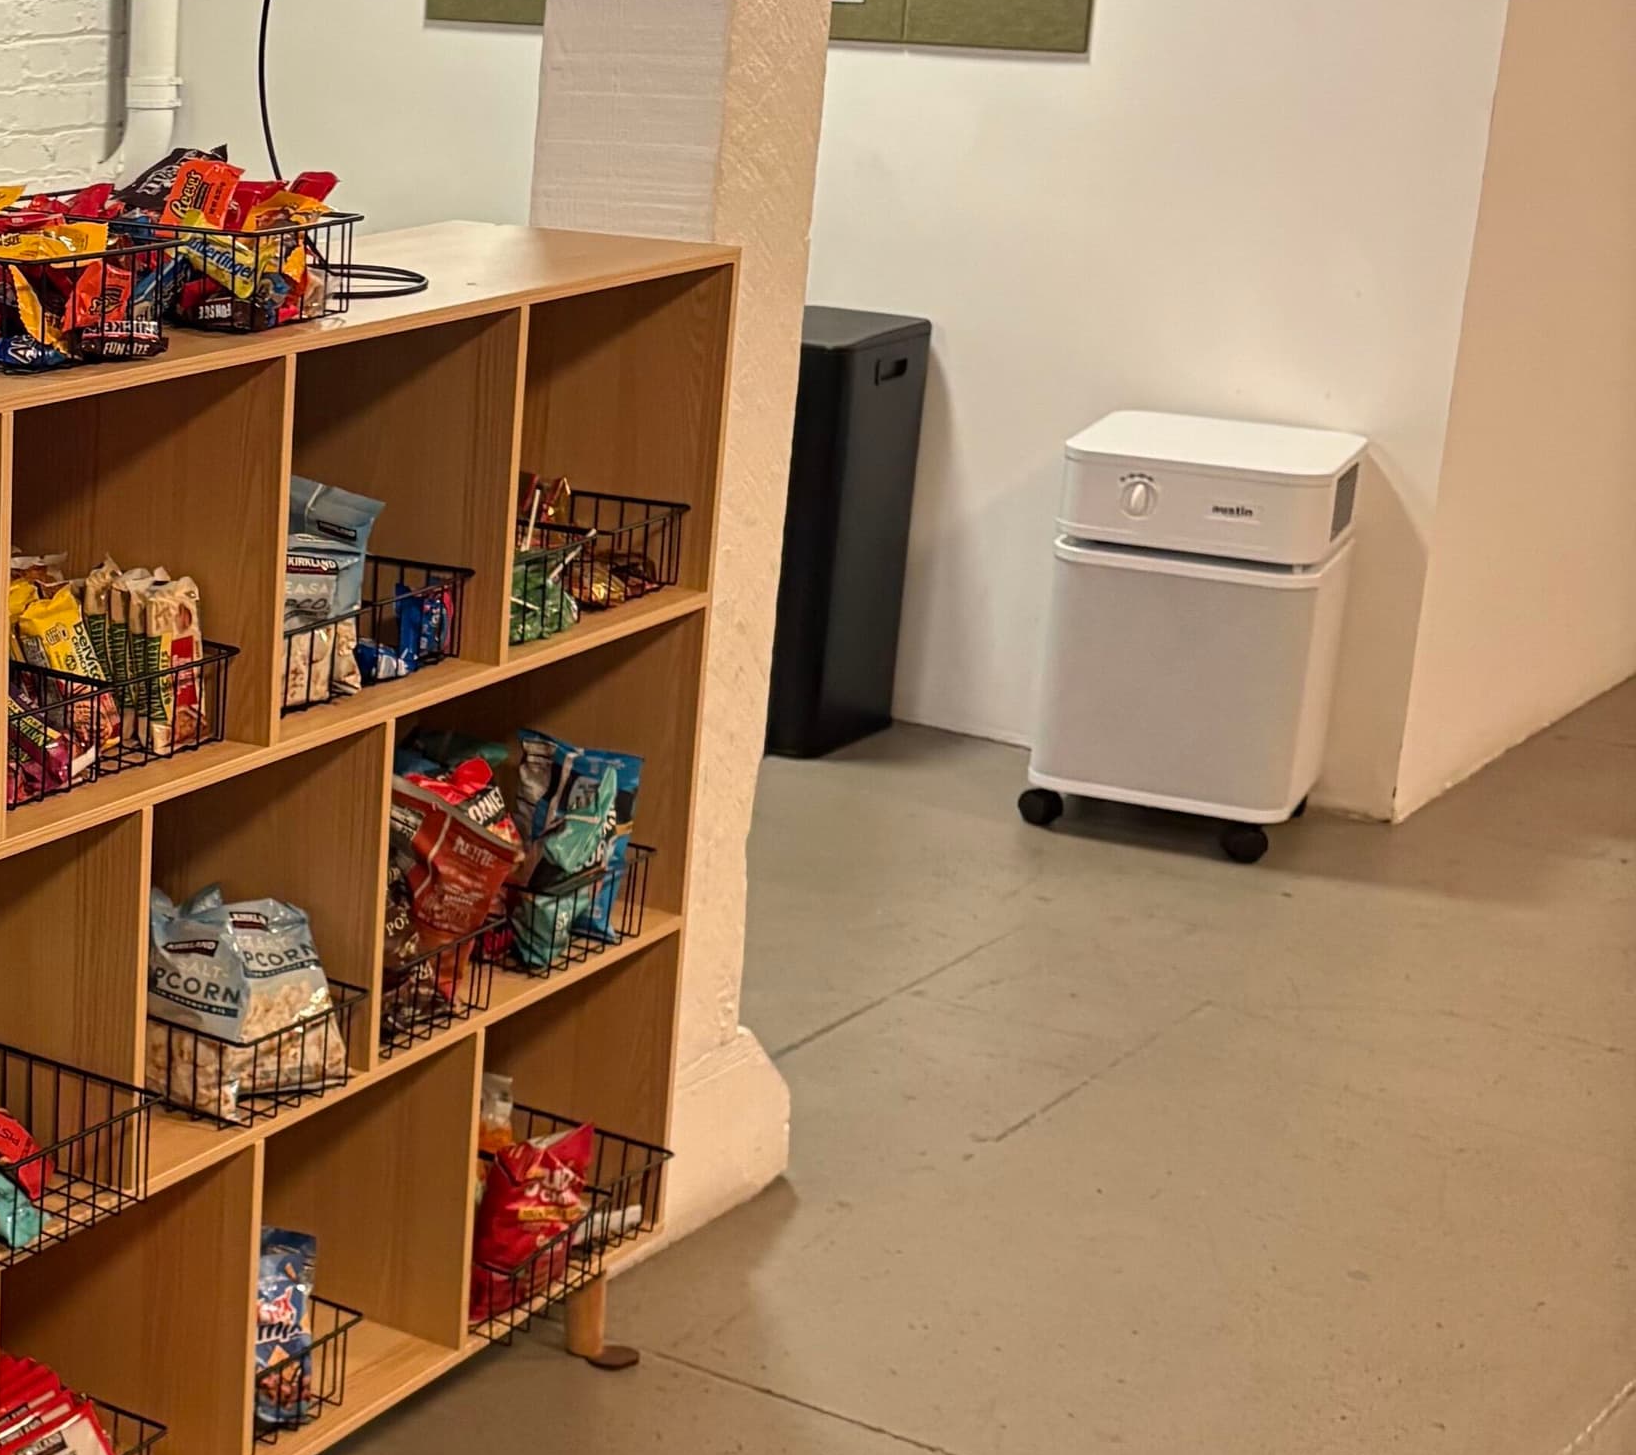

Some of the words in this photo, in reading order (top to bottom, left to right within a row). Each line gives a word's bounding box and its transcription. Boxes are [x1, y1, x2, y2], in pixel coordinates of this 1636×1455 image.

[170, 169, 203, 219] Reese's
[102, 339, 126, 356] FUN
[242, 943, 316, 968] PCORN
[152, 967, 241, 1003] PCORN
